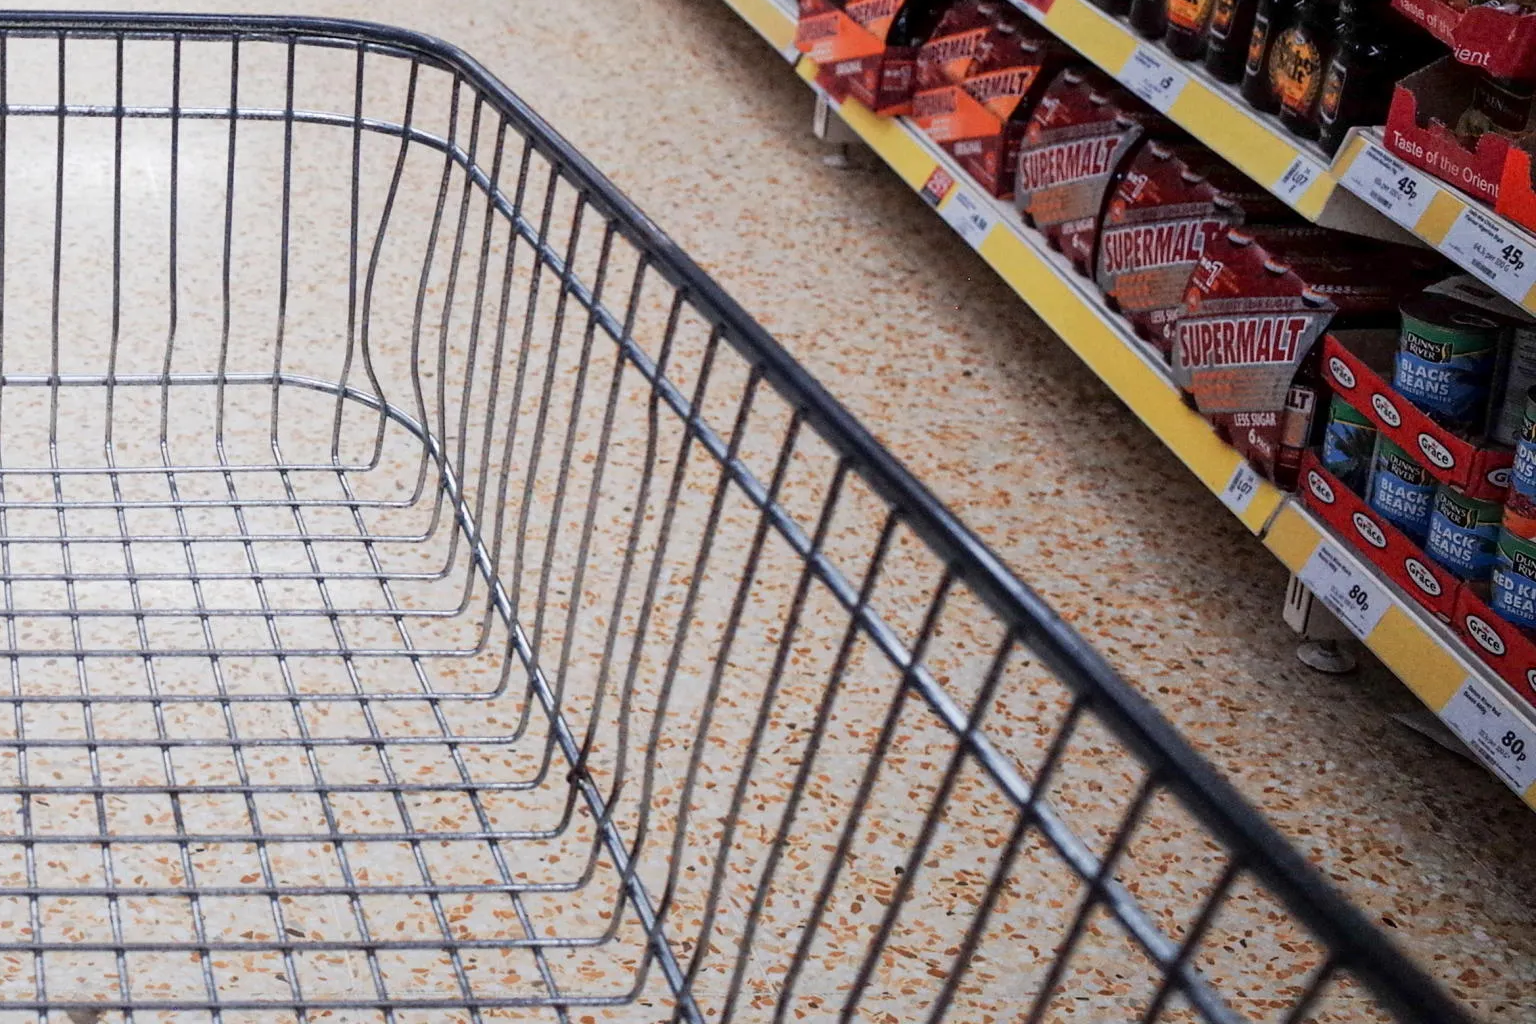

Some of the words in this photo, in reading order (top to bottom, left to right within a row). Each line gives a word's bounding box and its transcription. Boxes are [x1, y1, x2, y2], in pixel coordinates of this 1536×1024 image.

[1427, 11, 1438, 27] of
[1021, 135, 1122, 192] SUPERMALT
[1393, 130, 1423, 158] Taste
[1426, 150, 1439, 166] of
[1440, 155, 1459, 177] the
[1462, 166, 1500, 198] Orient
[1397, 177, 1417, 200] 45p
[1104, 219, 1224, 275] SUPERMALT
[1502, 244, 1524, 271] 45p
[1179, 317, 1308, 369] SUPERMALT
[1407, 333, 1441, 352] DUNN'S
[1409, 343, 1435, 360] RIVER
[1332, 361, 1352, 384] Grace
[1400, 371, 1449, 396] BEANS
[1401, 359, 1451, 384] BLACK
[1250, 412, 1277, 427] SUGAR
[1375, 398, 1397, 423] Grace
[1248, 428, 1256, 444] 6
[1421, 438, 1449, 465] Grace
[1391, 463, 1415, 483] RIVER
[1378, 490, 1427, 518] BEANS
[1381, 478, 1430, 504] BLACK
[1440, 505, 1462, 524] RIVER
[1357, 517, 1384, 544] Grace
[1432, 518, 1477, 550] BLACK
[1430, 530, 1472, 562] BEANS
[1409, 563, 1437, 592] Grace
[1493, 569, 1514, 590] RED
[1349, 584, 1369, 612] 80p
[1505, 603, 1535, 621] SALTED
[1470, 619, 1501, 652] Grace
[1501, 730, 1526, 762] 80p
